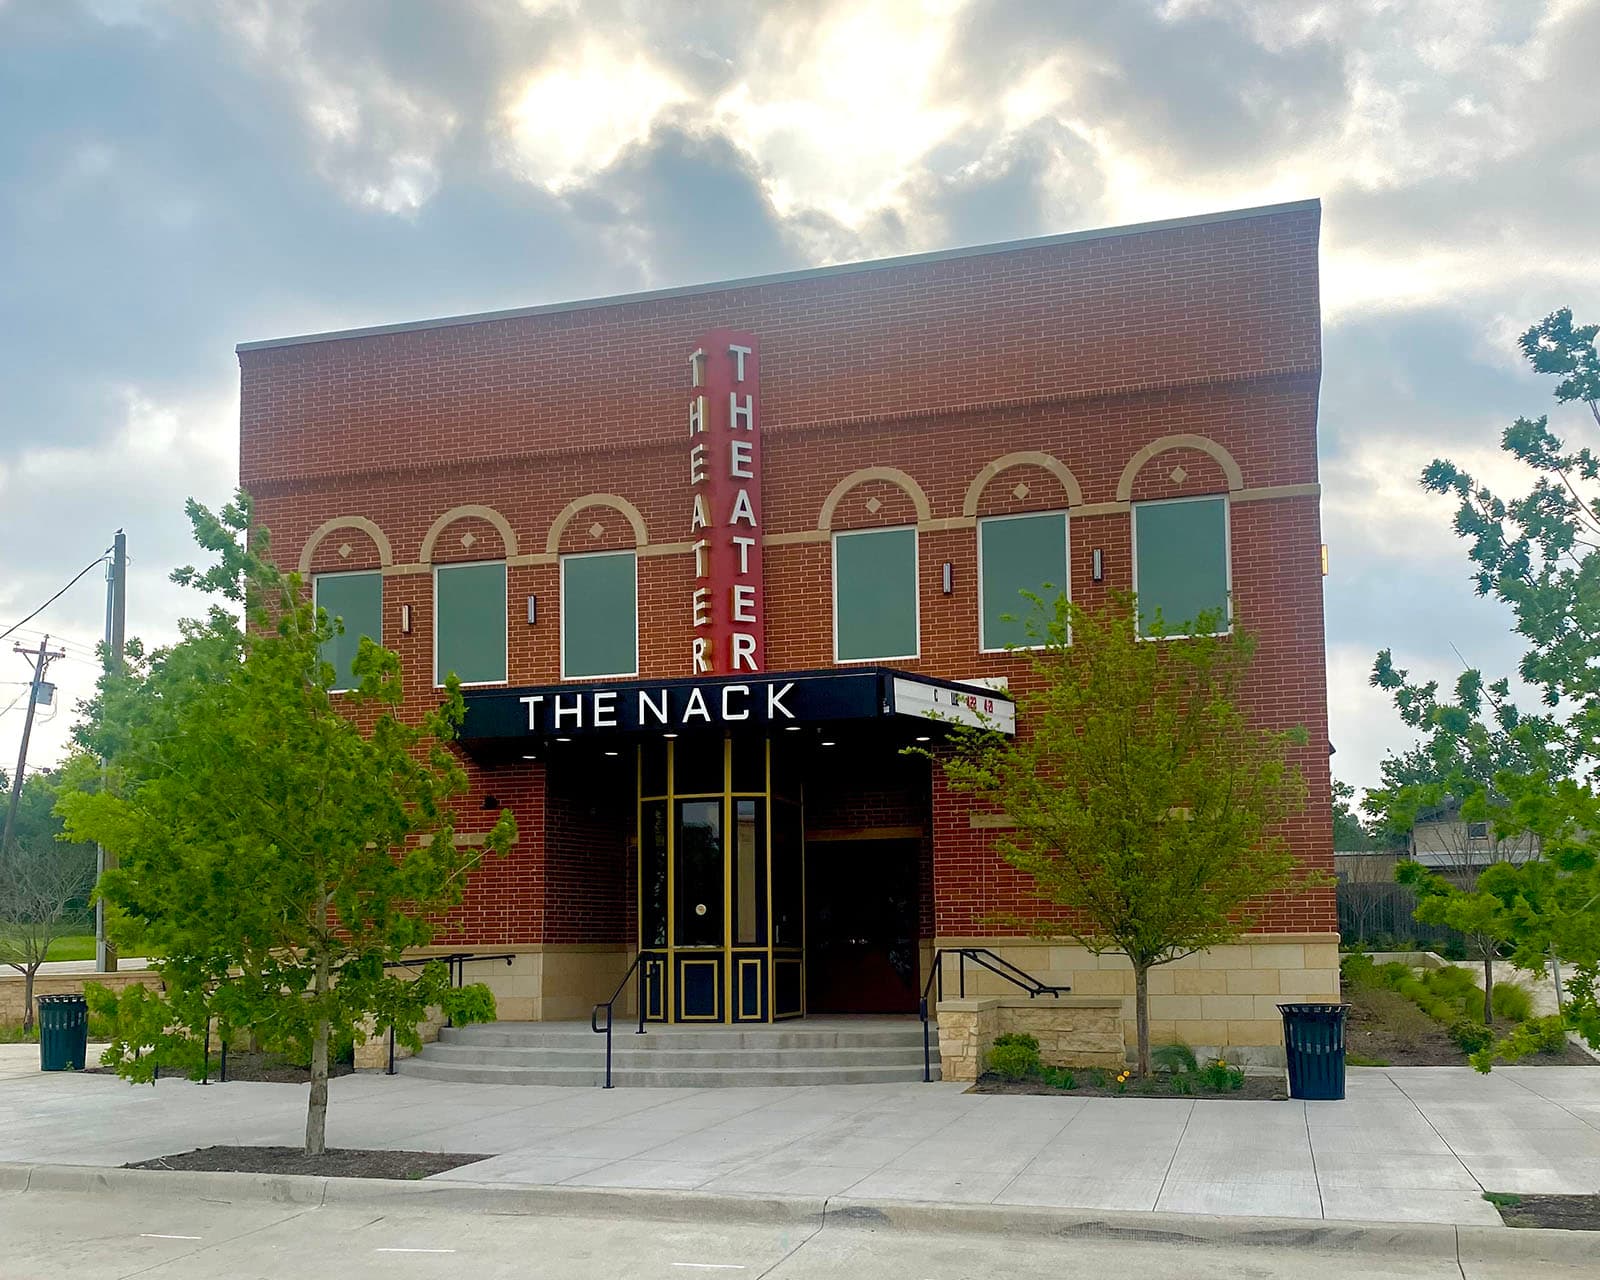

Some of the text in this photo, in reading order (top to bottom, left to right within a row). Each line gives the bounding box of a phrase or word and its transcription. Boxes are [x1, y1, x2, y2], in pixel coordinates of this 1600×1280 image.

[688, 347, 711, 675] THEATER
[728, 344, 758, 671] THEATER
[519, 683, 796, 730] THE NACK
